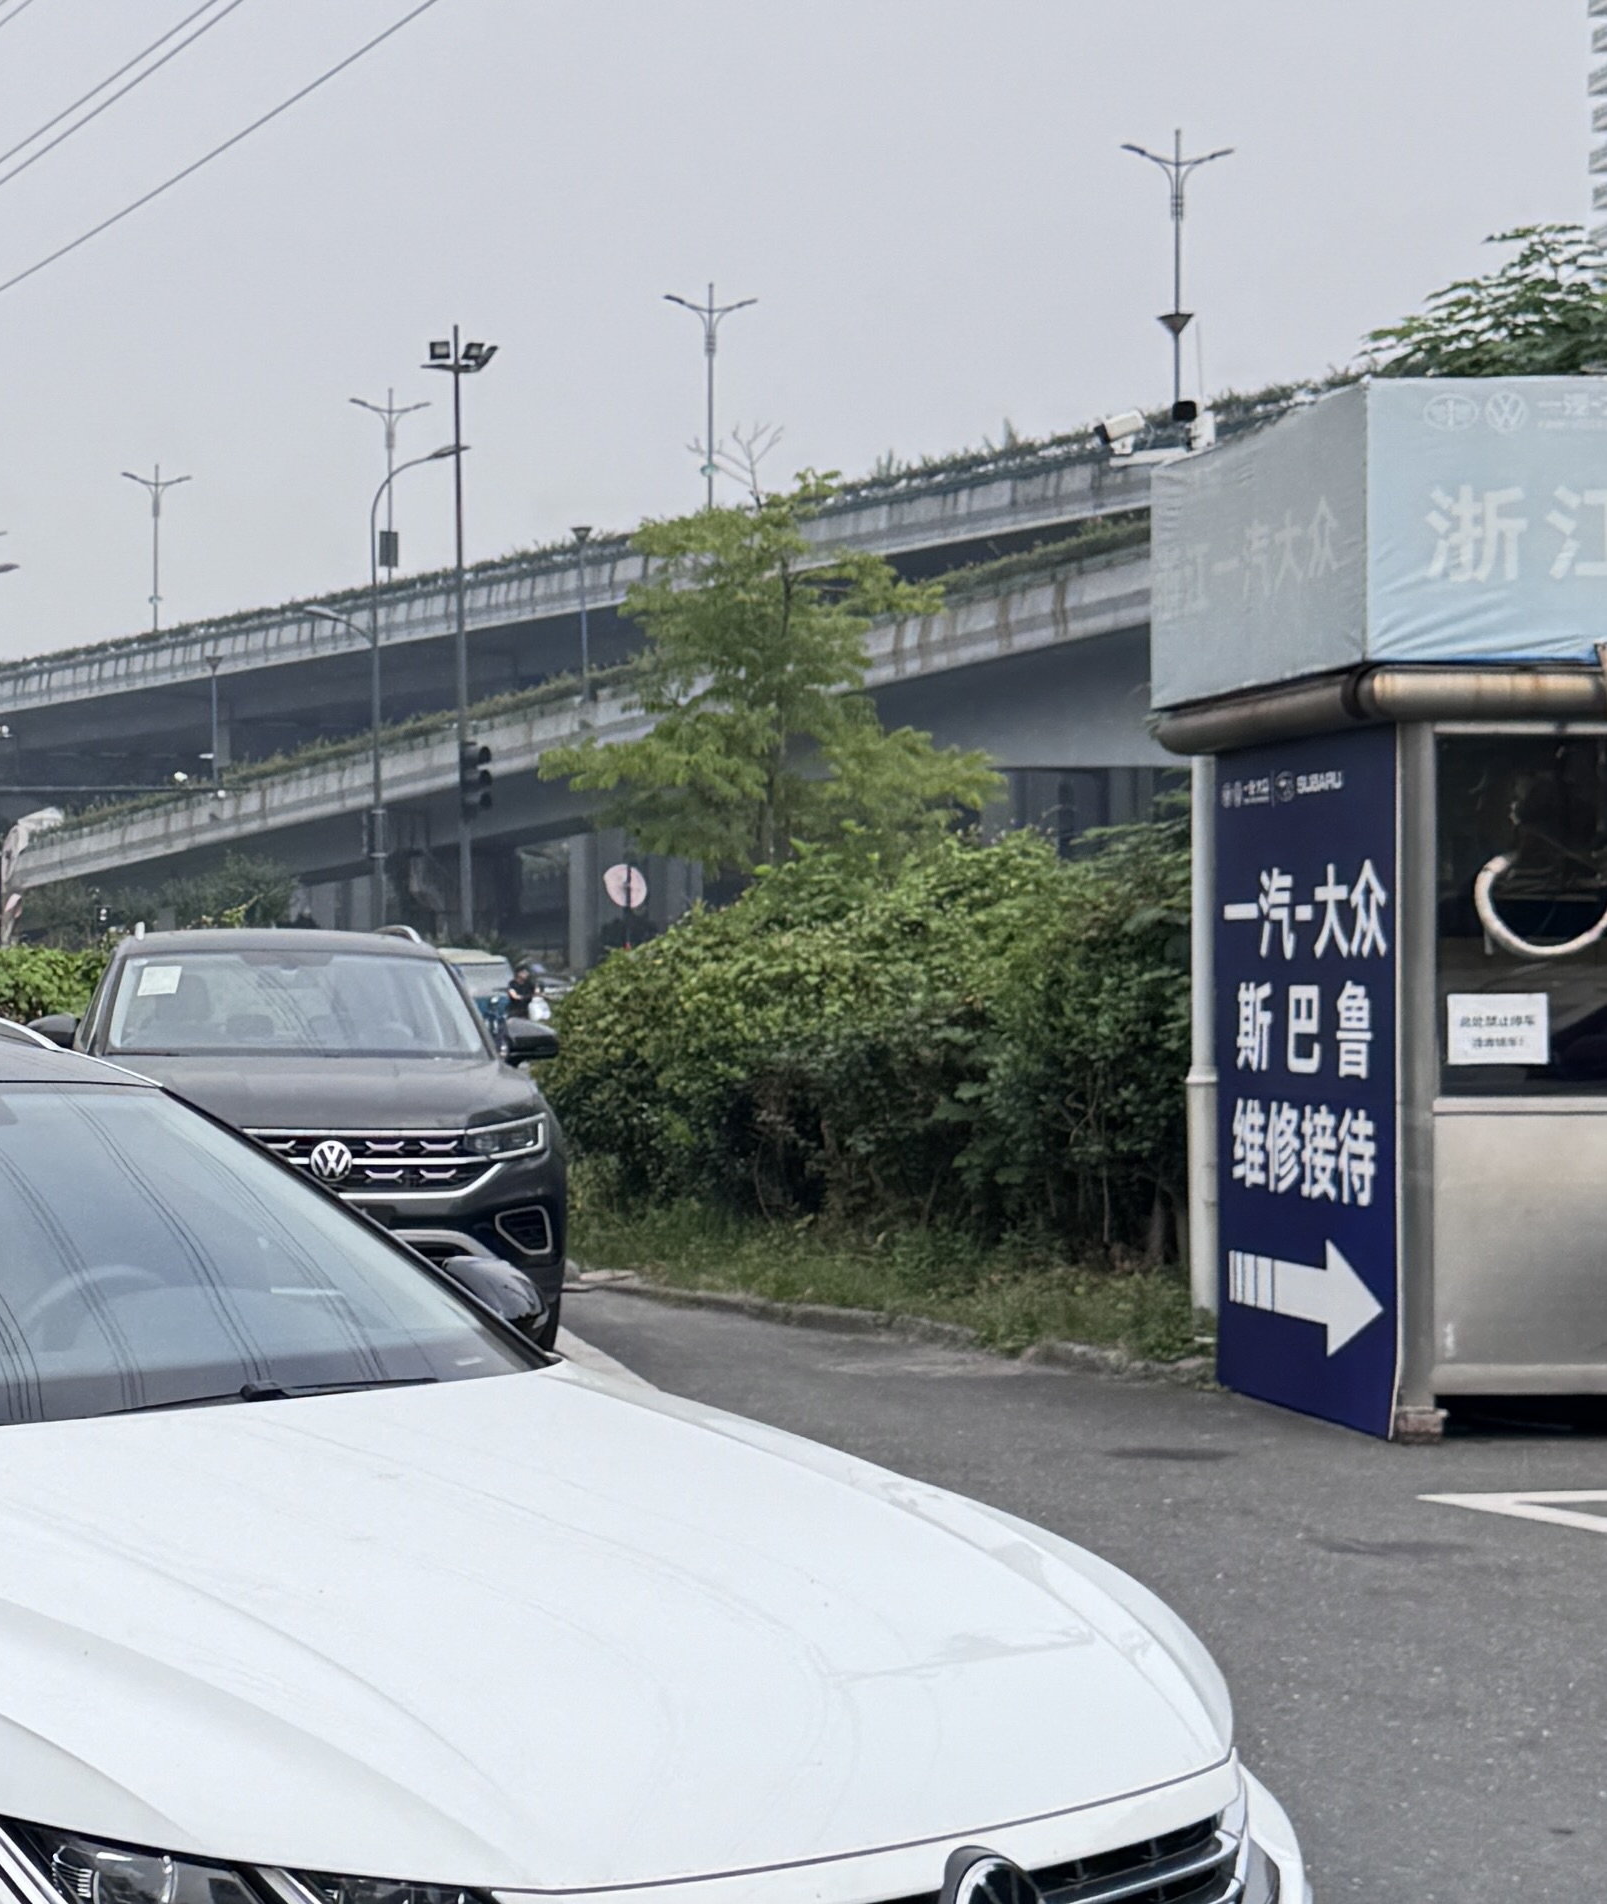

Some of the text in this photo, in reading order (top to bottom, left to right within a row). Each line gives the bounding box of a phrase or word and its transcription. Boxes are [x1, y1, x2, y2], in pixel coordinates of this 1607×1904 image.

[1223, 858, 1387, 960] 一汽-大众
[1236, 980, 1373, 1079] 斯巴鲁
[1232, 1097, 1376, 1206] 维修接待
